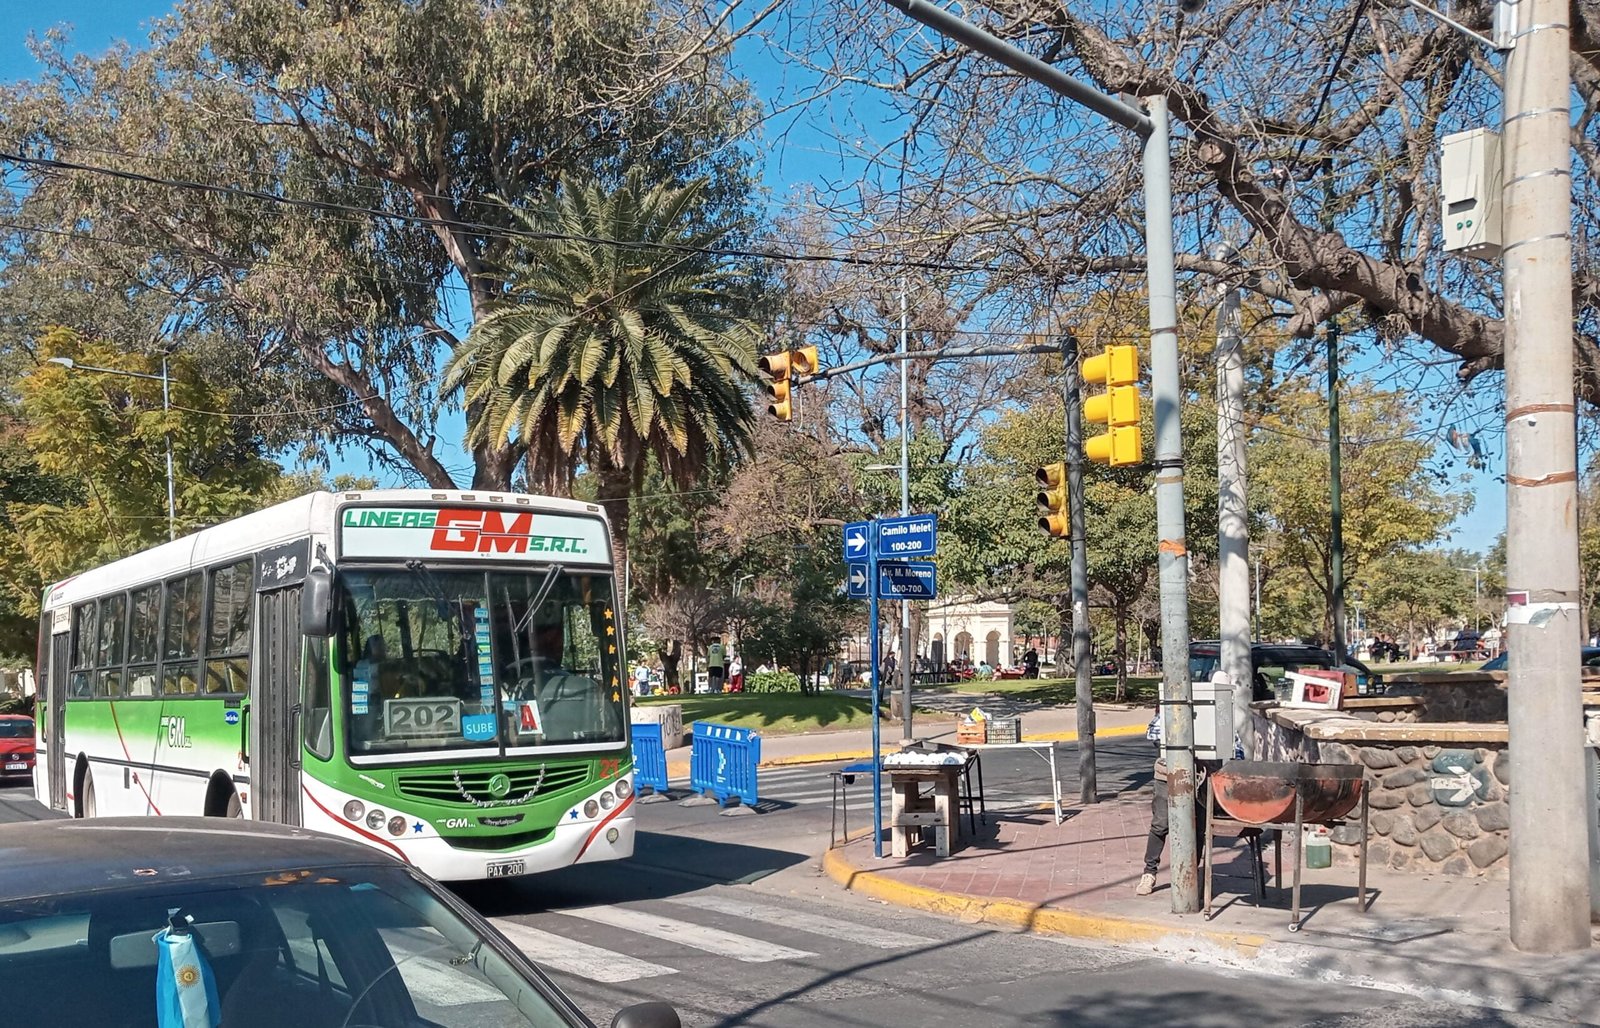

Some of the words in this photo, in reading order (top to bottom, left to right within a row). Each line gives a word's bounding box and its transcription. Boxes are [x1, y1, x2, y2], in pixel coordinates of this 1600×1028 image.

[344, 511, 437, 528] LINEAS
[430, 509, 533, 553] GM
[529, 536, 588, 554] S.R.L.
[881, 525, 908, 536] Camilo
[909, 522, 932, 533] Melet
[891, 541, 922, 551] 100-200
[882, 568, 893, 577] Av.
[895, 568, 903, 577] M.
[905, 568, 932, 578] Moreno
[892, 585, 922, 593] 600-700
[392, 705, 454, 729] 202
[520, 704, 538, 731] A
[168, 715, 185, 748] GM
[466, 722, 493, 734] SUBE
[599, 758, 619, 779] 21
[446, 818, 467, 828] GM
[488, 866, 503, 878] PAX
[507, 863, 523, 876] 200
